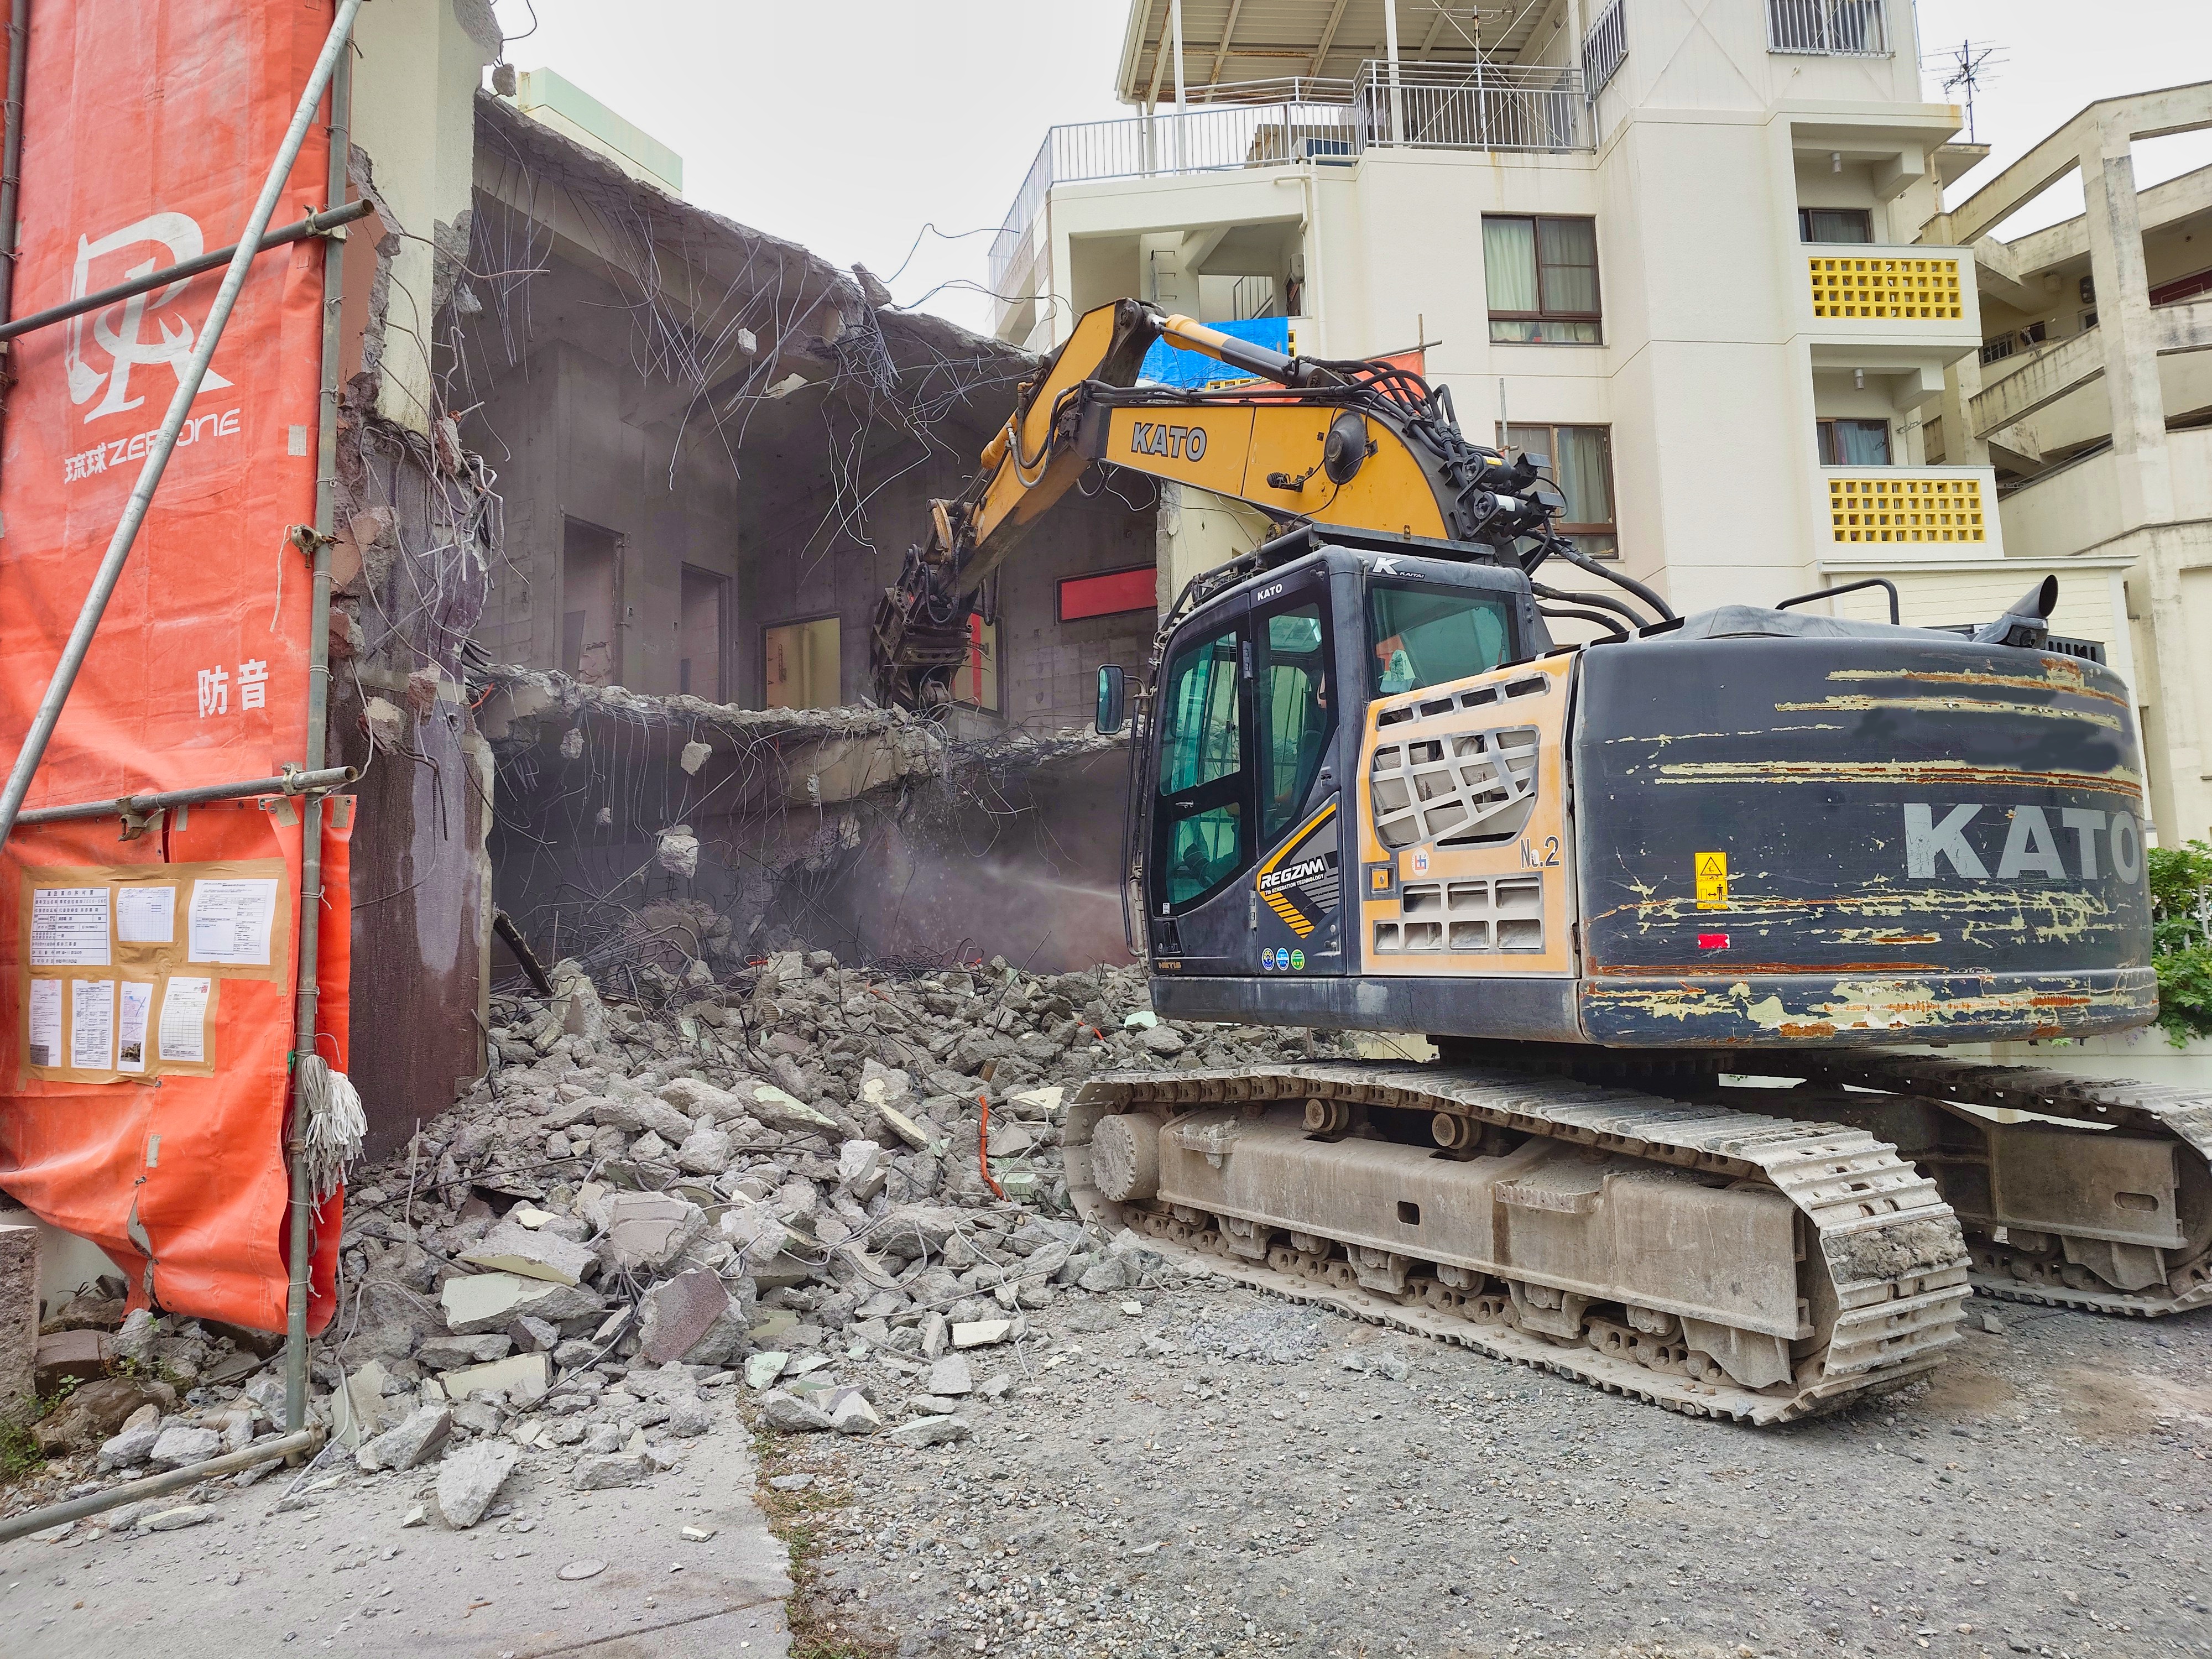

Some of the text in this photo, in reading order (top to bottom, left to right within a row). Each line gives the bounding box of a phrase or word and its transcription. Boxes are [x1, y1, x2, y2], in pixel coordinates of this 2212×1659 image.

[1131, 422, 1207, 462] KATO
[1257, 583, 1282, 601] KATO
[197, 658, 269, 718] 防音
[1903, 803, 2141, 884] KATO
[1271, 881, 1296, 893] GENERATION
[1296, 873, 1324, 886] TECHNOLOGY
